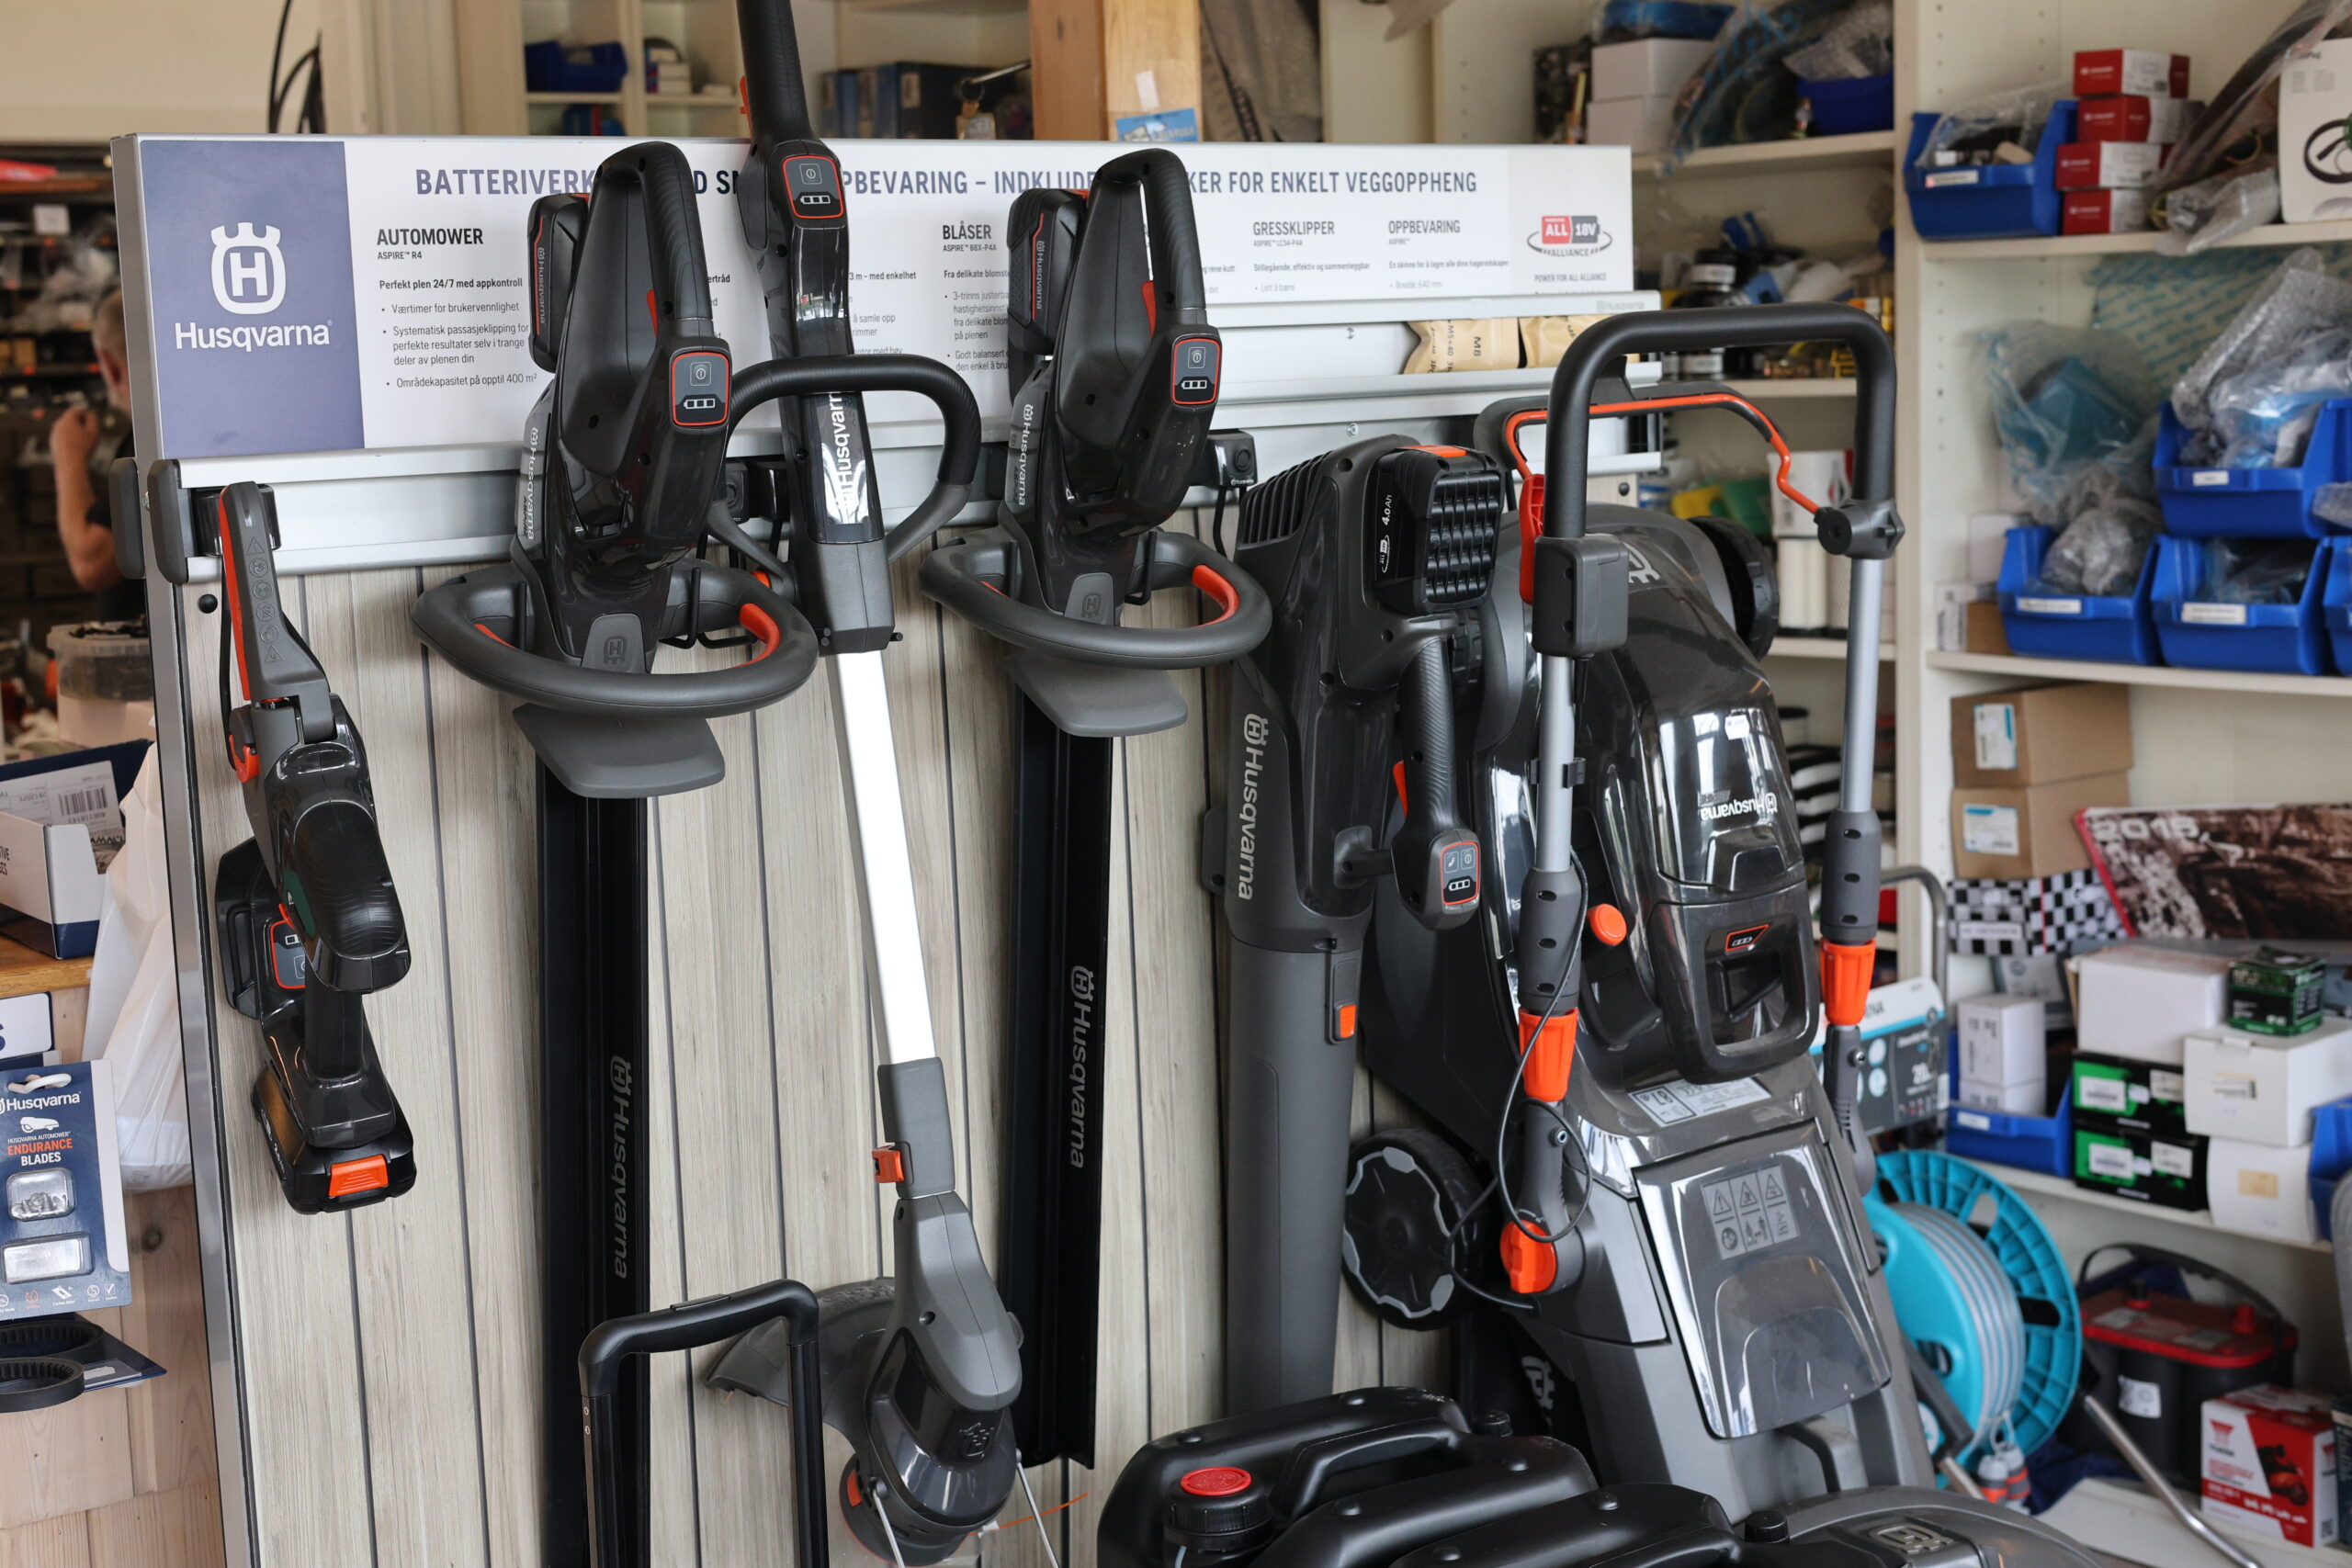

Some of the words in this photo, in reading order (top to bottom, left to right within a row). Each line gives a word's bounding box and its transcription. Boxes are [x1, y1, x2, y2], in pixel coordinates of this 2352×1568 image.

[416, 169, 595, 195] BATTERIVERK
[1229, 171, 1264, 193] FOR
[1271, 171, 1340, 193] ENKELT
[1346, 171, 1477, 193] VEGGOPPHENG
[943, 220, 992, 240] BLÅSER
[1252, 220, 1336, 236] GRESSKLIPPER
[1388, 220, 1461, 234] OPPBEVARING
[1545, 222, 1568, 237] ALL
[1575, 222, 1597, 236] 18V
[377, 228, 484, 245] AUTOMOWER
[412, 251, 423, 260] R4
[1551, 248, 1589, 257] ALLIANCE
[869, 272, 884, 280] med
[886, 271, 917, 280] enkelhet
[944, 270, 955, 278] Fra
[956, 269, 983, 278] delikate
[379, 279, 411, 289] Perfekt
[413, 279, 431, 290] plen
[433, 278, 454, 288] 24/7
[456, 278, 474, 288] med
[476, 277, 523, 290] appkontroll
[1035, 253, 1044, 310] Husqvarna
[953, 291, 980, 301] 3-trinns
[391, 303, 432, 314] Værtimer
[435, 302, 447, 313] for
[448, 302, 520, 314] brukervennlighet
[859, 314, 881, 323] samle
[882, 314, 896, 324] opp
[954, 318, 964, 326] fra
[175, 321, 331, 353] Husqvarna
[393, 325, 446, 336] Systematisk
[447, 324, 516, 336] passasjeklipping
[517, 323, 529, 333] for
[955, 331, 964, 341] på
[965, 331, 989, 341] plenen
[393, 341, 429, 352] perfekte
[431, 339, 472, 350] resultater
[474, 338, 492, 348] selv
[497, 338, 525, 349] trange
[394, 355, 415, 366] deler
[418, 356, 428, 365] av
[431, 355, 459, 366] plenen
[461, 354, 474, 364] din
[955, 350, 971, 359] Godt
[973, 349, 1005, 359] balansert
[956, 363, 968, 371] den
[970, 362, 989, 371] enkel
[396, 376, 468, 388] Områdekapasitet
[469, 376, 481, 387] på
[482, 375, 504, 386] opptil
[506, 373, 524, 383] 400
[1018, 422, 1032, 506] Husqvarna
[526, 448, 537, 540] Husqvarna
[1701, 796, 1765, 820] Husqvarna
[1238, 747, 1264, 900] Husqvarna
[1069, 1001, 1091, 1168] Husqvarna
[6, 1093, 81, 1111] Husqvarna
[7, 1138, 74, 1156] ENDURANCE
[21, 1152, 62, 1167] BLADES
[611, 1095, 630, 1279] Husqvarna
